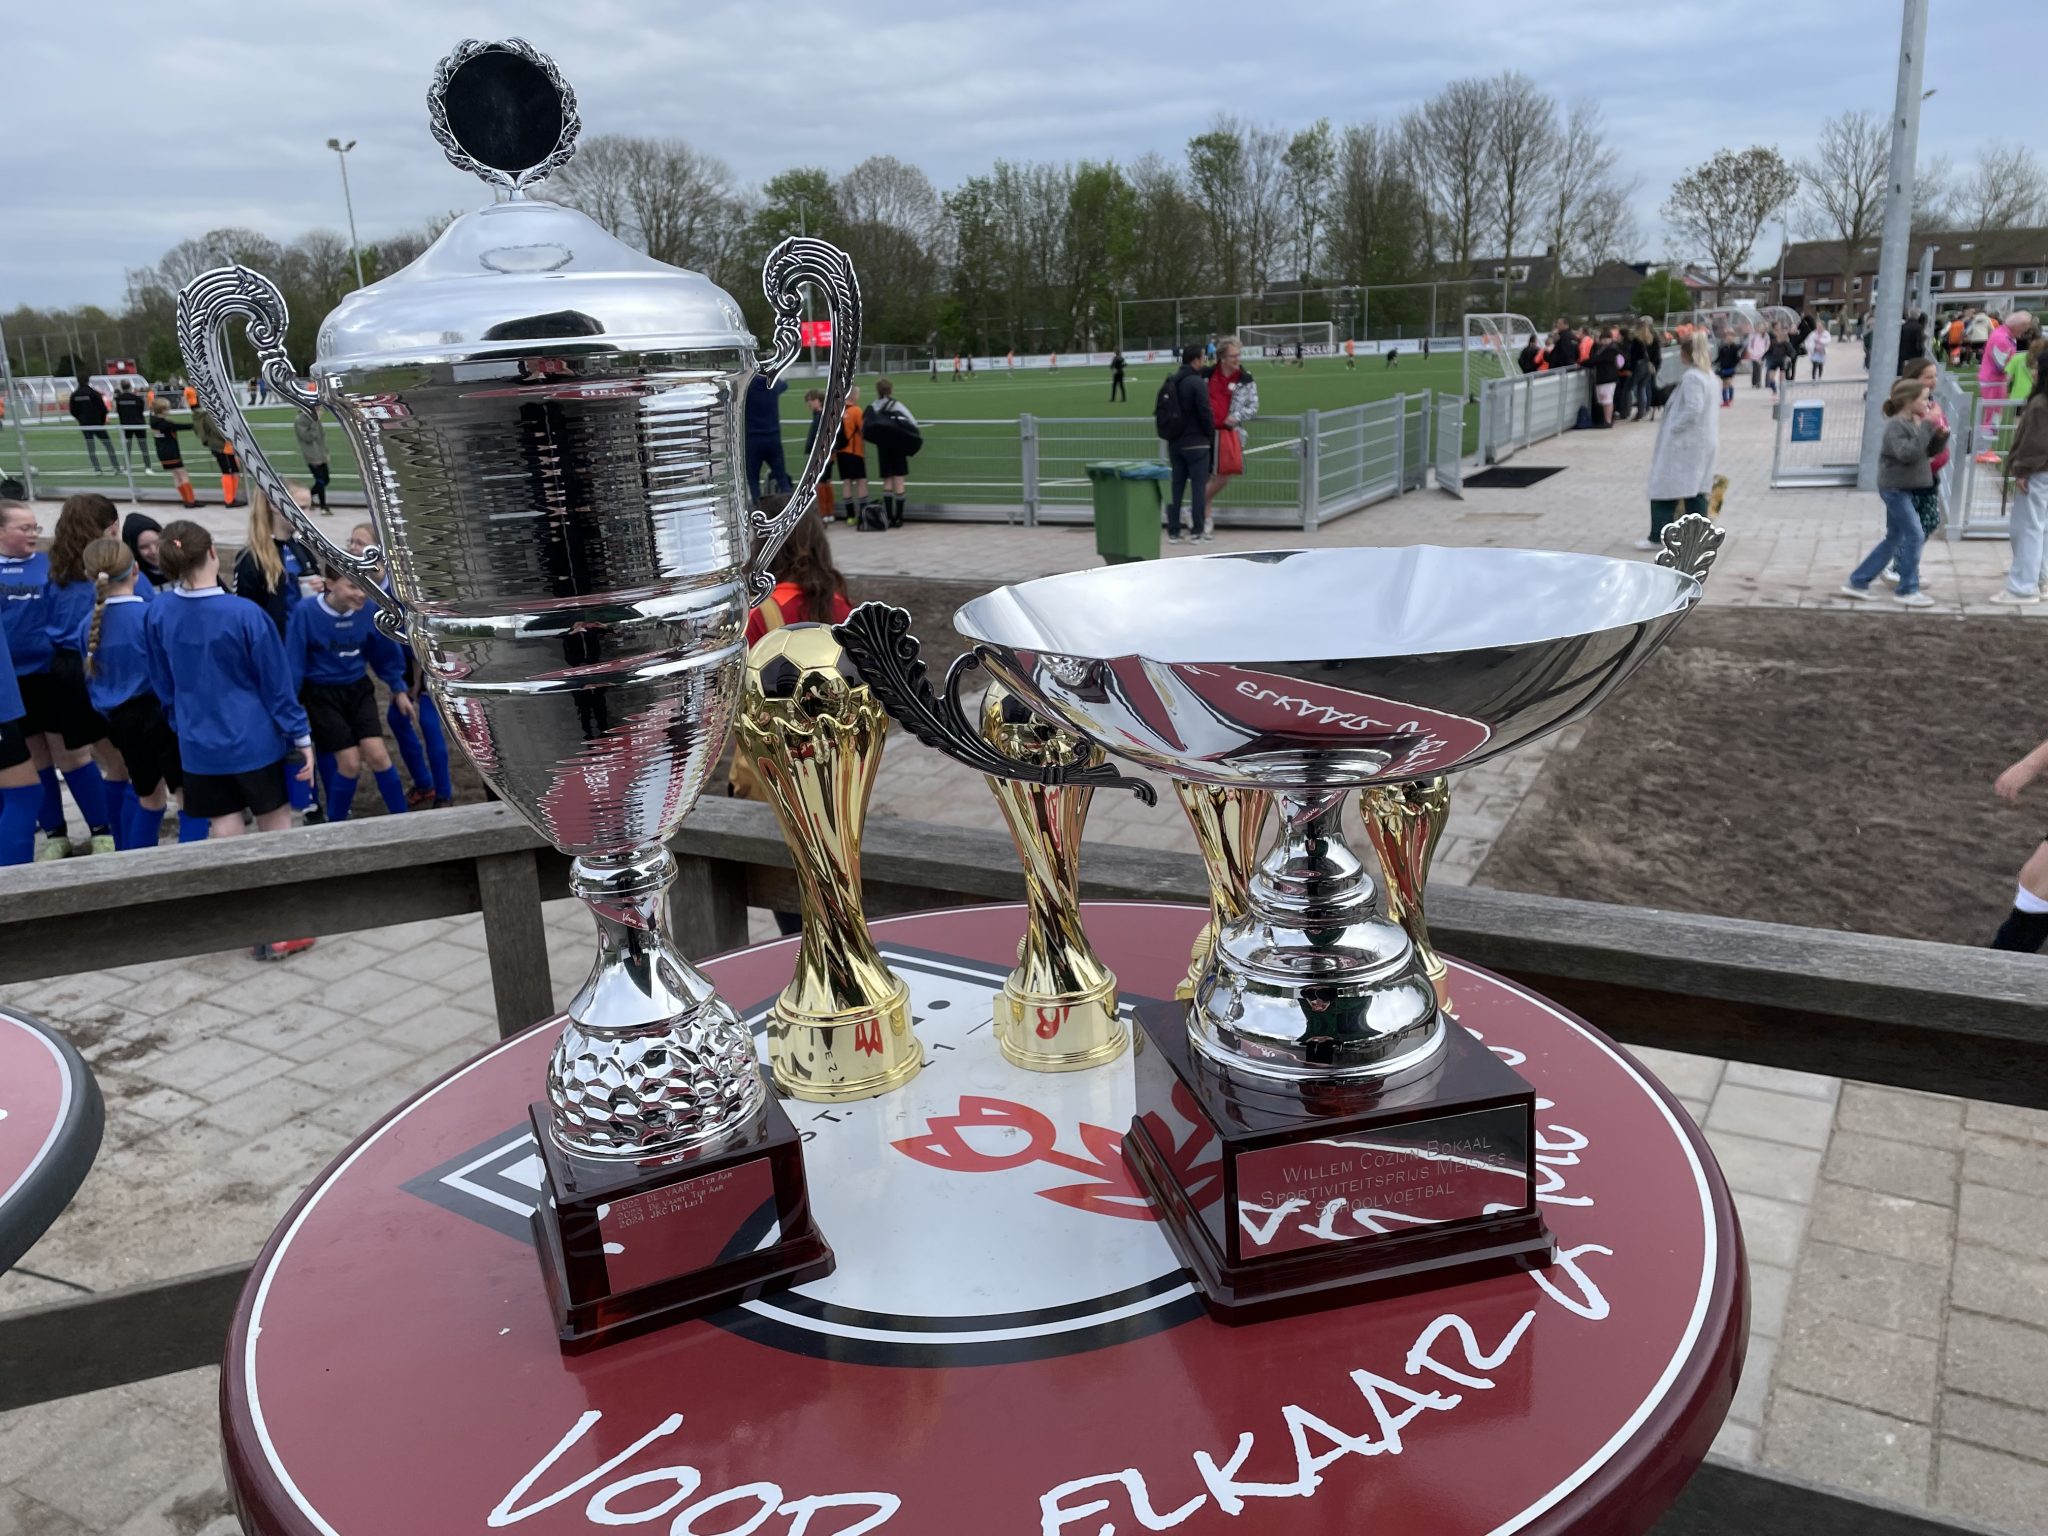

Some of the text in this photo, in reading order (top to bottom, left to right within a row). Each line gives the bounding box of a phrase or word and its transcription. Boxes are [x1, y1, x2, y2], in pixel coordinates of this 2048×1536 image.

[1260, 1151, 1507, 1208] SPORTIVITEITSPRIJS MEISJES
[1282, 1136, 1492, 1184] WILLEM COZIJN BOKAAL
[665, 1182, 695, 1198] VAART
[1315, 1182, 1456, 1218] SCHOOLVOETBAL
[1039, 1312, 1537, 1536] ELKAAR
